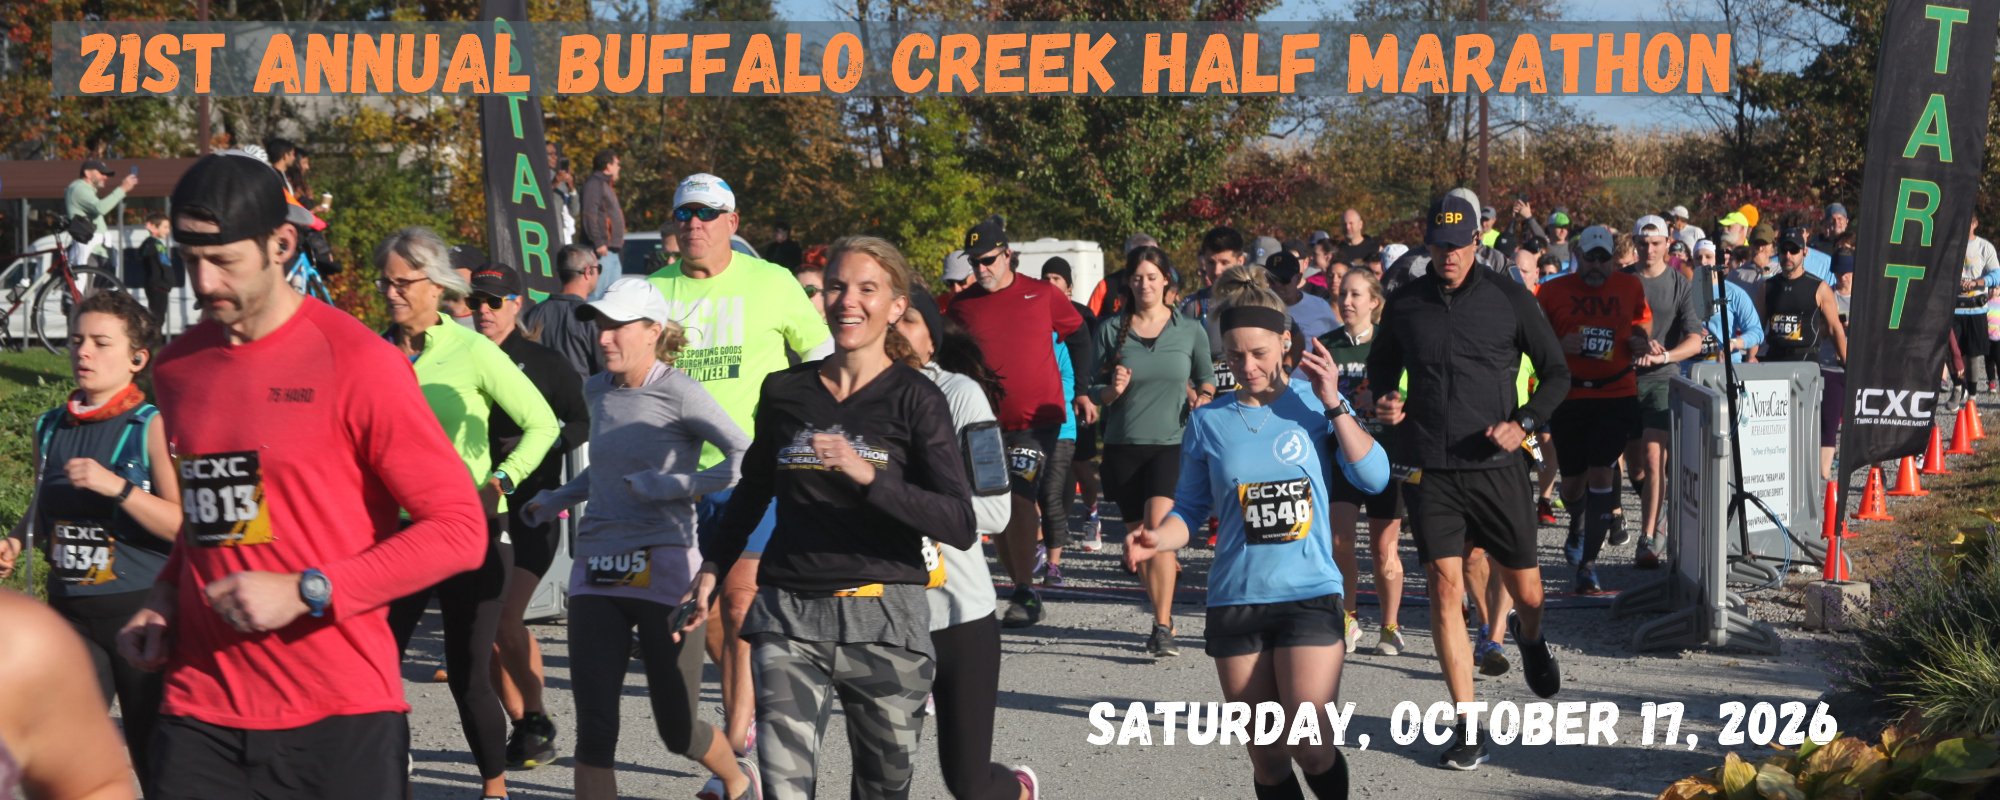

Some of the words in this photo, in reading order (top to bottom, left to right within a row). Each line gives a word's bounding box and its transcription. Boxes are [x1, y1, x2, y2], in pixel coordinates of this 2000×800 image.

[1435, 212, 1463, 225] CBP
[970, 233, 979, 246] P
[1582, 327, 1614, 338] GCXC
[687, 347, 719, 359] SPORTING
[720, 346, 742, 355] GOODS
[703, 355, 742, 367] MARATHON
[1750, 391, 1788, 418] NovaCare
[1880, 418, 1931, 427] MANAGEMENT
[180, 456, 250, 480] GCXC
[1246, 481, 1306, 500] GCXC
[183, 484, 259, 524] 4813
[1245, 499, 1311, 529] 4540
[55, 525, 105, 541] GCXC
[52, 543, 110, 571] 4634
